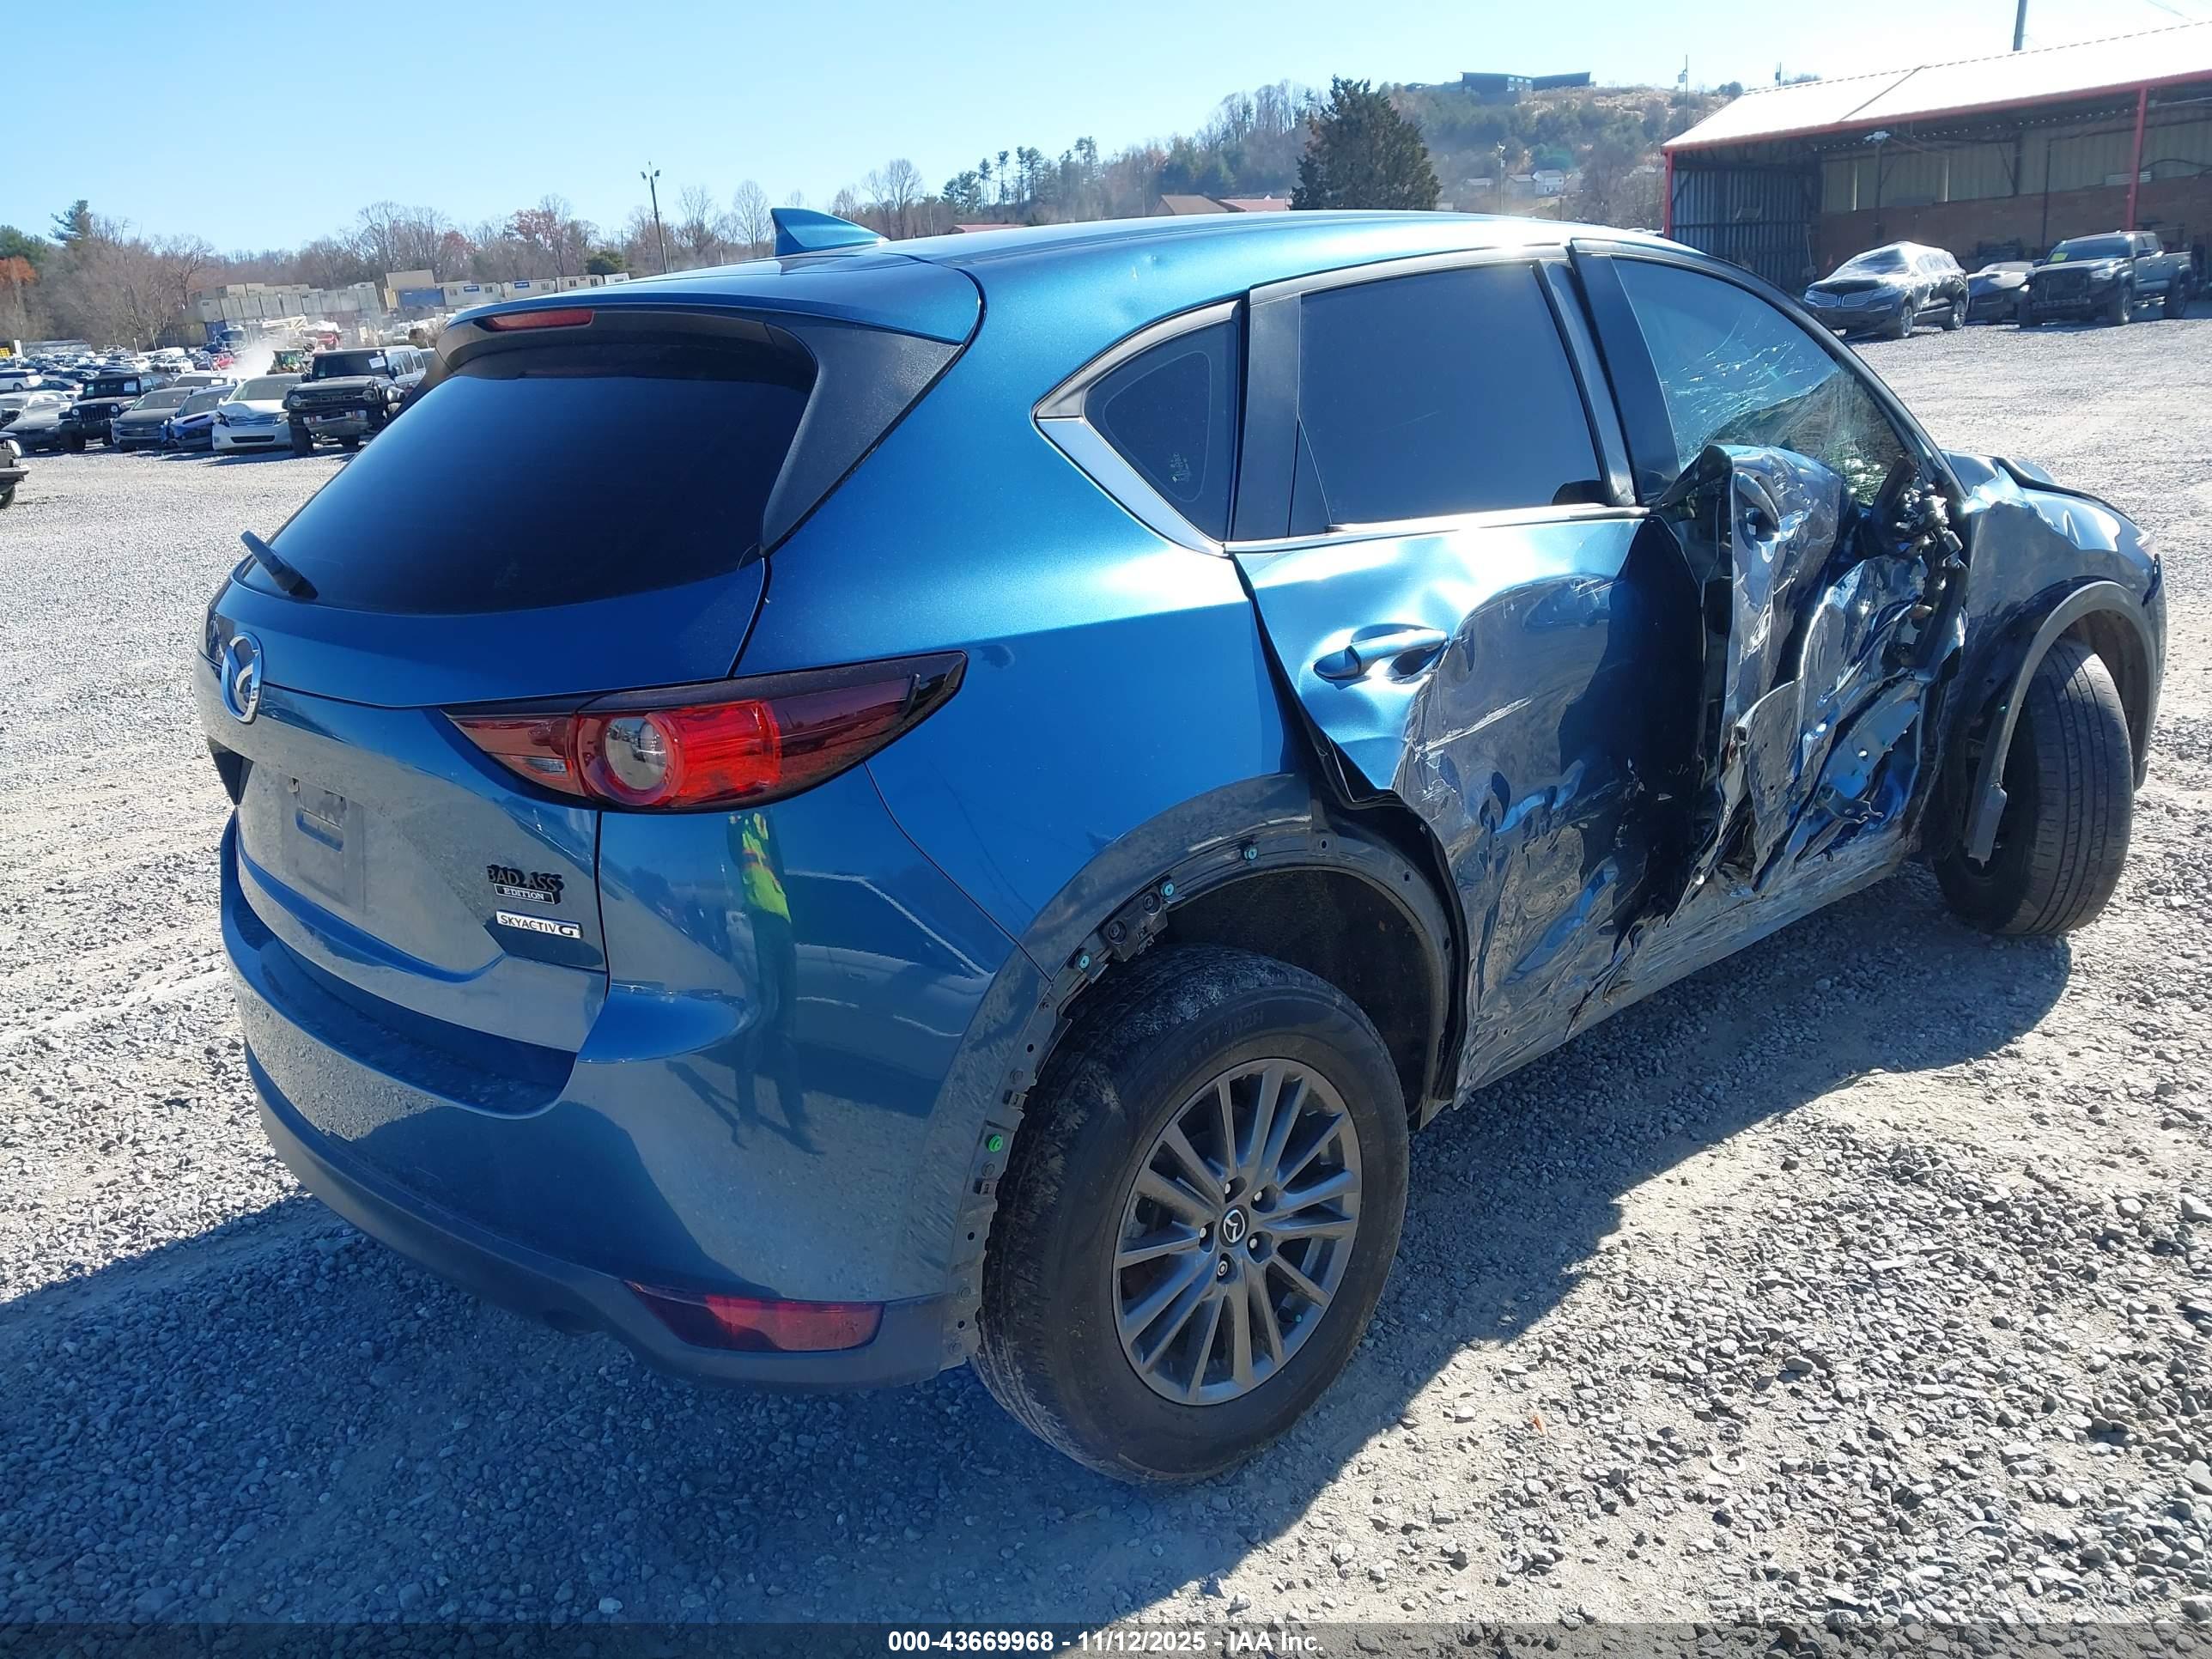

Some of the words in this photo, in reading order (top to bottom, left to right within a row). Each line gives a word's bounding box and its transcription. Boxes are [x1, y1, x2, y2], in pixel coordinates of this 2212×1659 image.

[487, 866, 520, 885] BAD
[523, 874, 559, 892] ASS
[502, 887, 544, 901] EDITION
